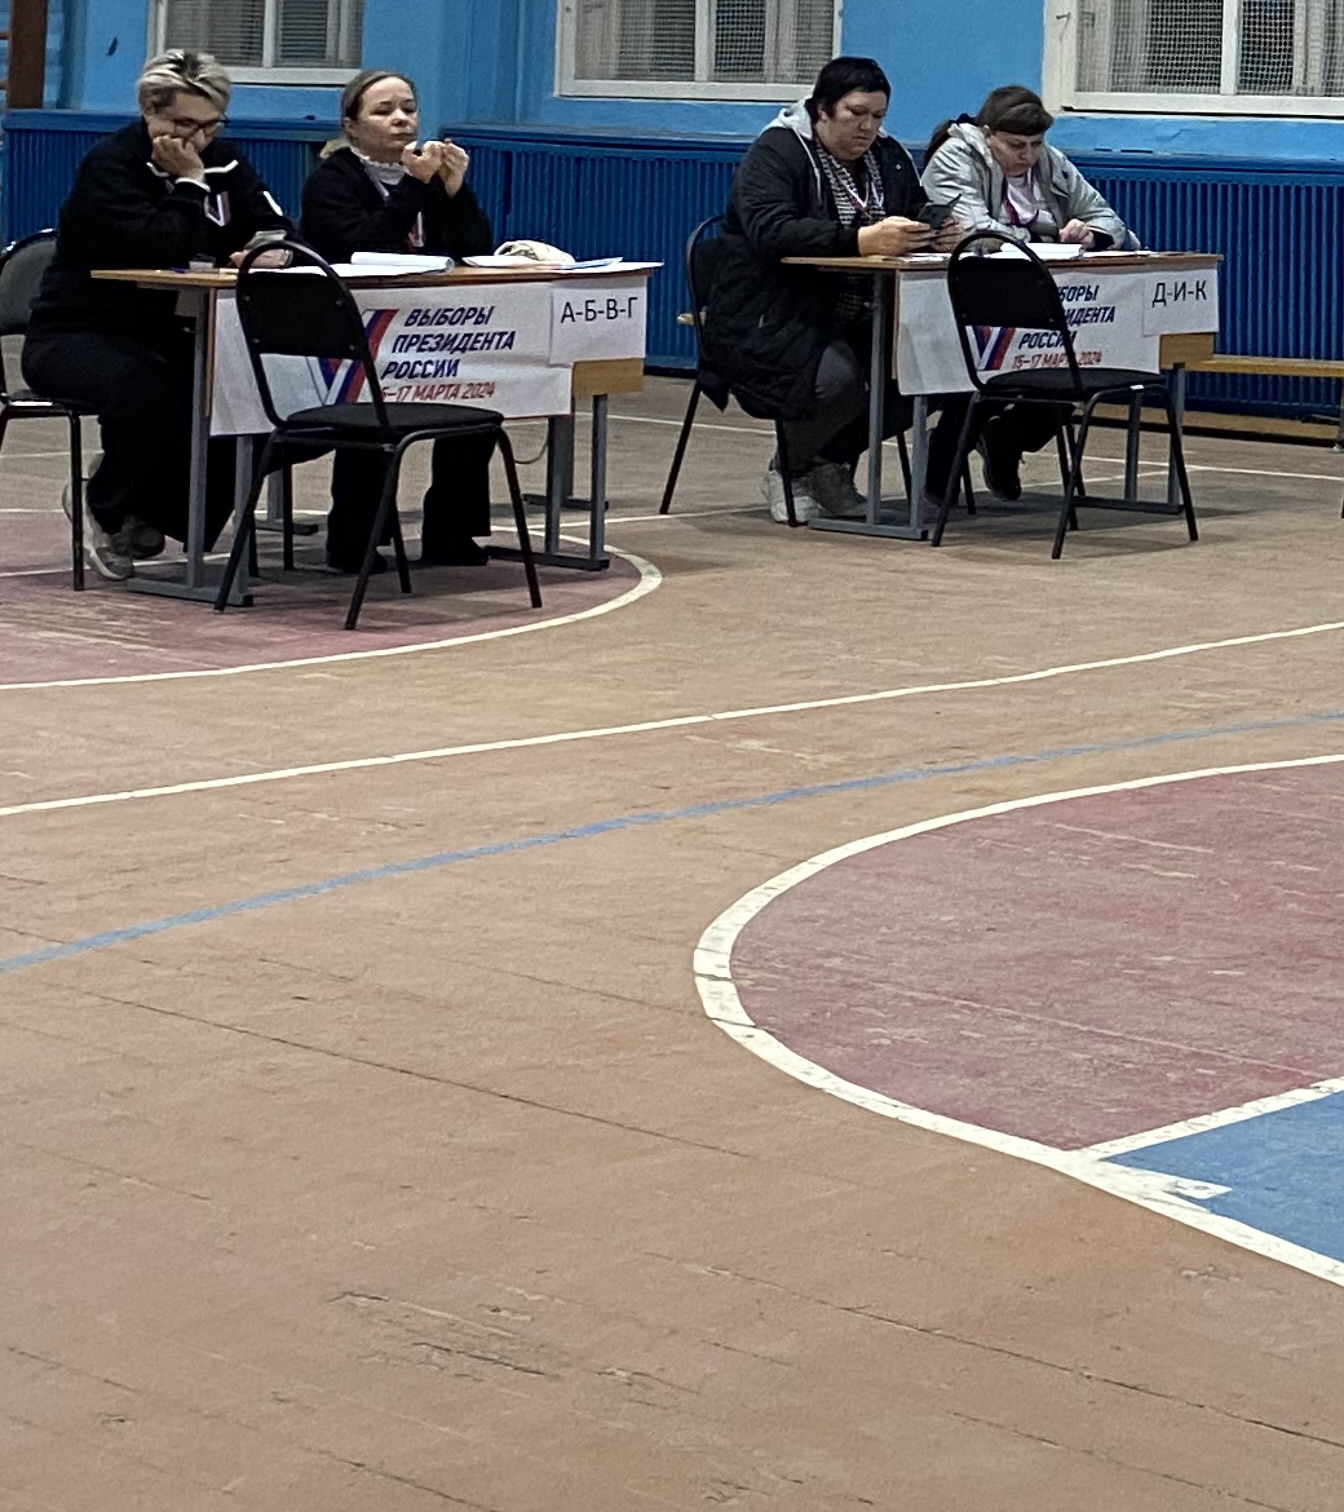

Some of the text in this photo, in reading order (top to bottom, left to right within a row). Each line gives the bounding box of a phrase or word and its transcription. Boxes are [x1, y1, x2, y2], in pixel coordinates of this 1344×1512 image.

[1059, 285, 1099, 302] БОРЫ
[1152, 280, 1207, 308] Д-И-К
[404, 306, 496, 327] ВЫБОРЫ
[560, 296, 638, 323] А-Б-В-Г
[1066, 306, 1115, 326] ИДЕНТА
[392, 330, 516, 354] ПРЕЗИДЕНТА
[381, 359, 460, 379] РОССИИ
[381, 381, 496, 402] 5–17 МАРТА 2024
